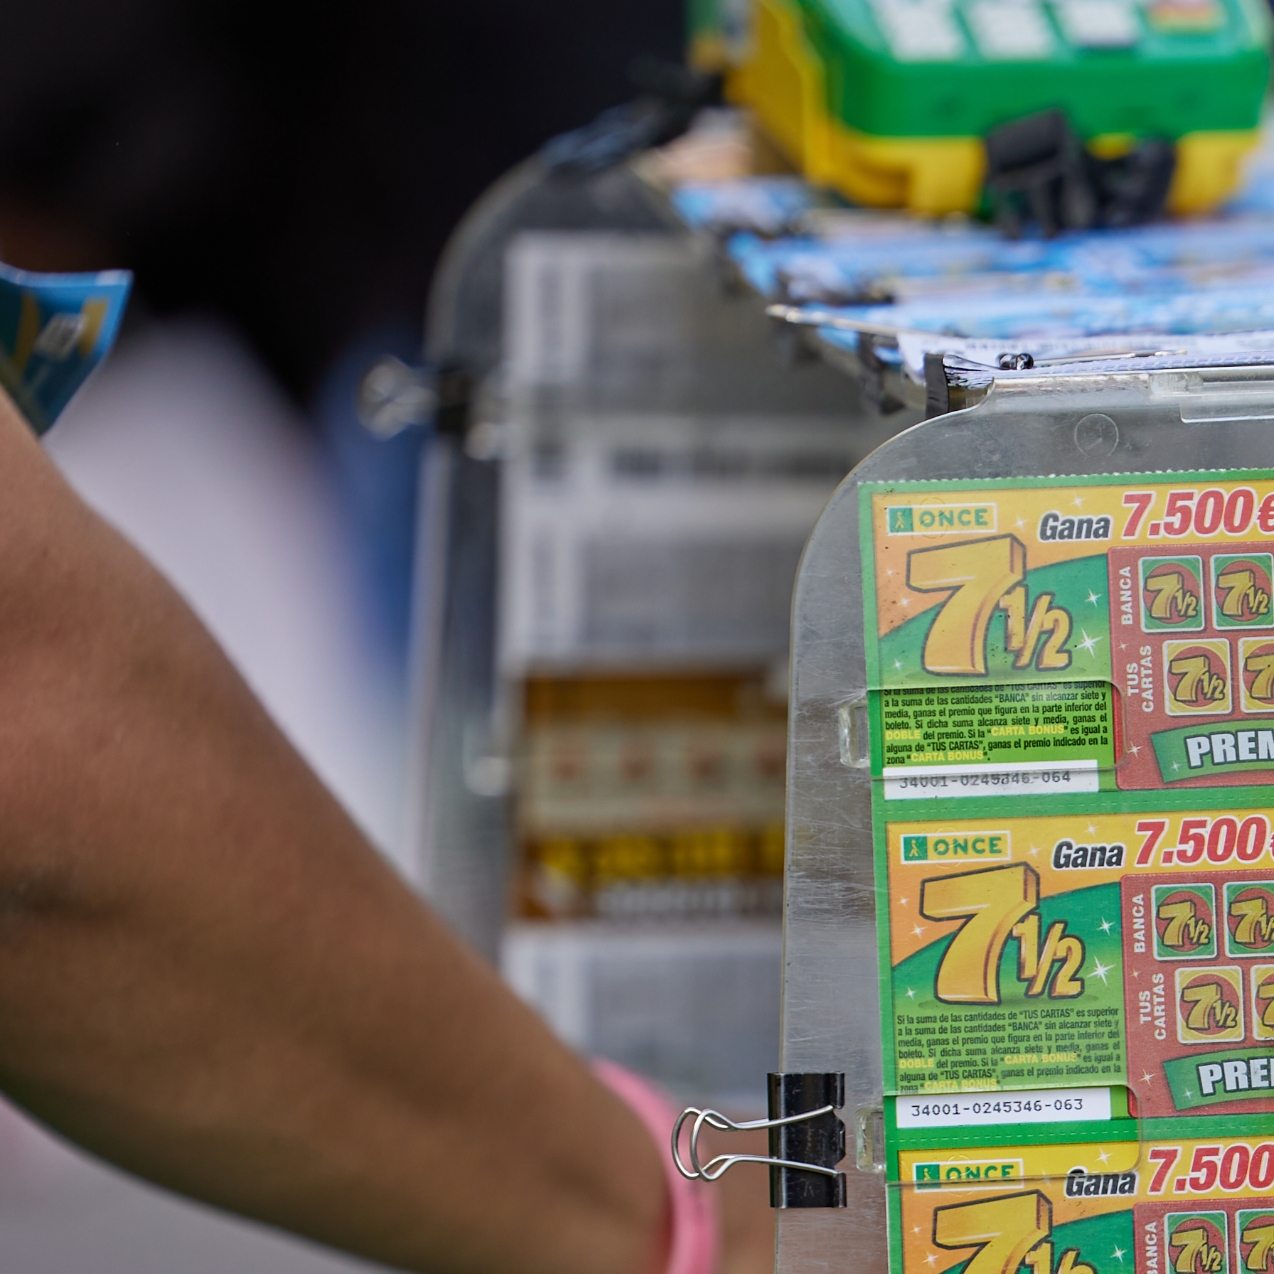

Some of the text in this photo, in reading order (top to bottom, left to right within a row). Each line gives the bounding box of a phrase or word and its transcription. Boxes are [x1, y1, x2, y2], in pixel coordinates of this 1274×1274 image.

[917, 509, 989, 529] ONCE
[1039, 510, 1111, 542] Gana
[1120, 566, 1132, 626] BANCA
[1126, 662, 1139, 696] TUS
[1140, 644, 1154, 713] CARTAS
[933, 836, 1002, 857] ONCE
[1052, 838, 1123, 870] Gana
[911, 1099, 1083, 1116] 34001-0245346-063
[946, 1164, 1015, 1181] ONCE
[1065, 1167, 1136, 1197] Gana
